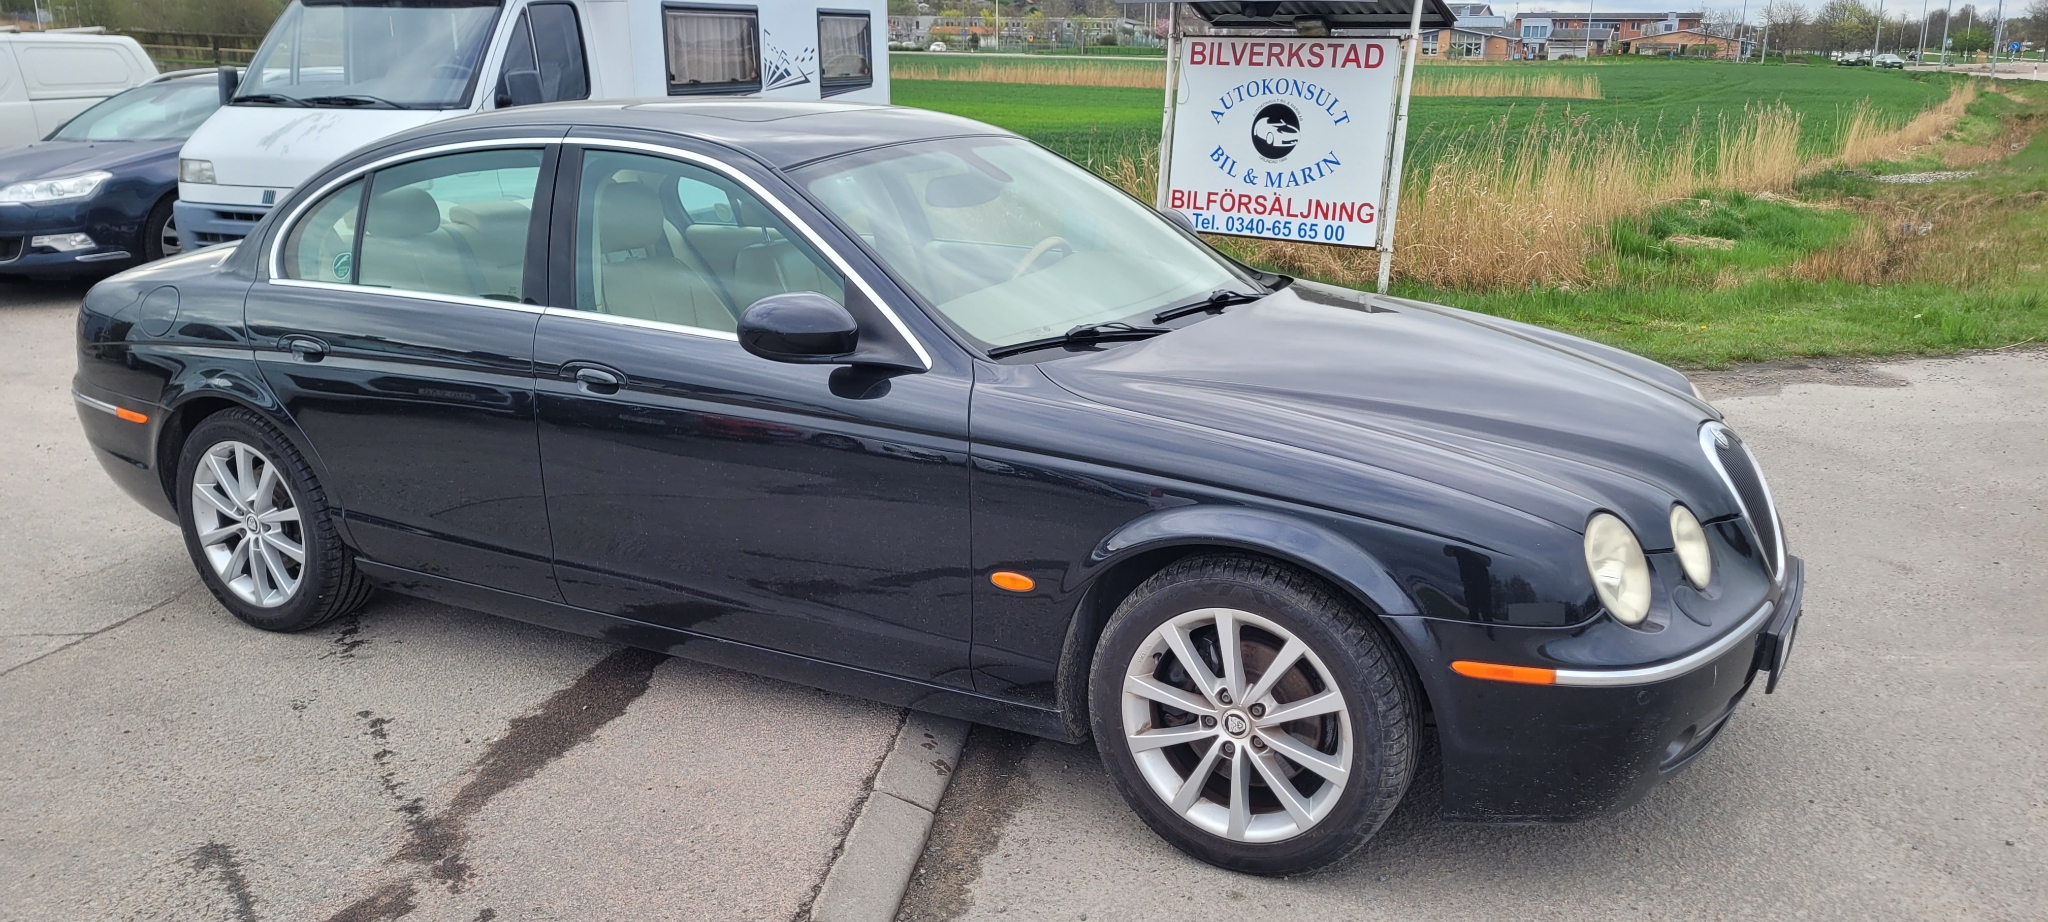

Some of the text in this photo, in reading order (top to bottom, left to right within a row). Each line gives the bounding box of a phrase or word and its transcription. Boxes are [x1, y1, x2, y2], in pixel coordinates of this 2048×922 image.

[1189, 41, 1385, 69] BILVERKSTAD
[1210, 77, 1350, 126] AUTOKONSULT
[1209, 145, 1342, 189] BIL & MARIN
[1171, 188, 1375, 224] BILFÖRSÄLJNING
[1192, 212, 1346, 242] Tel. 0340-65 65 00
